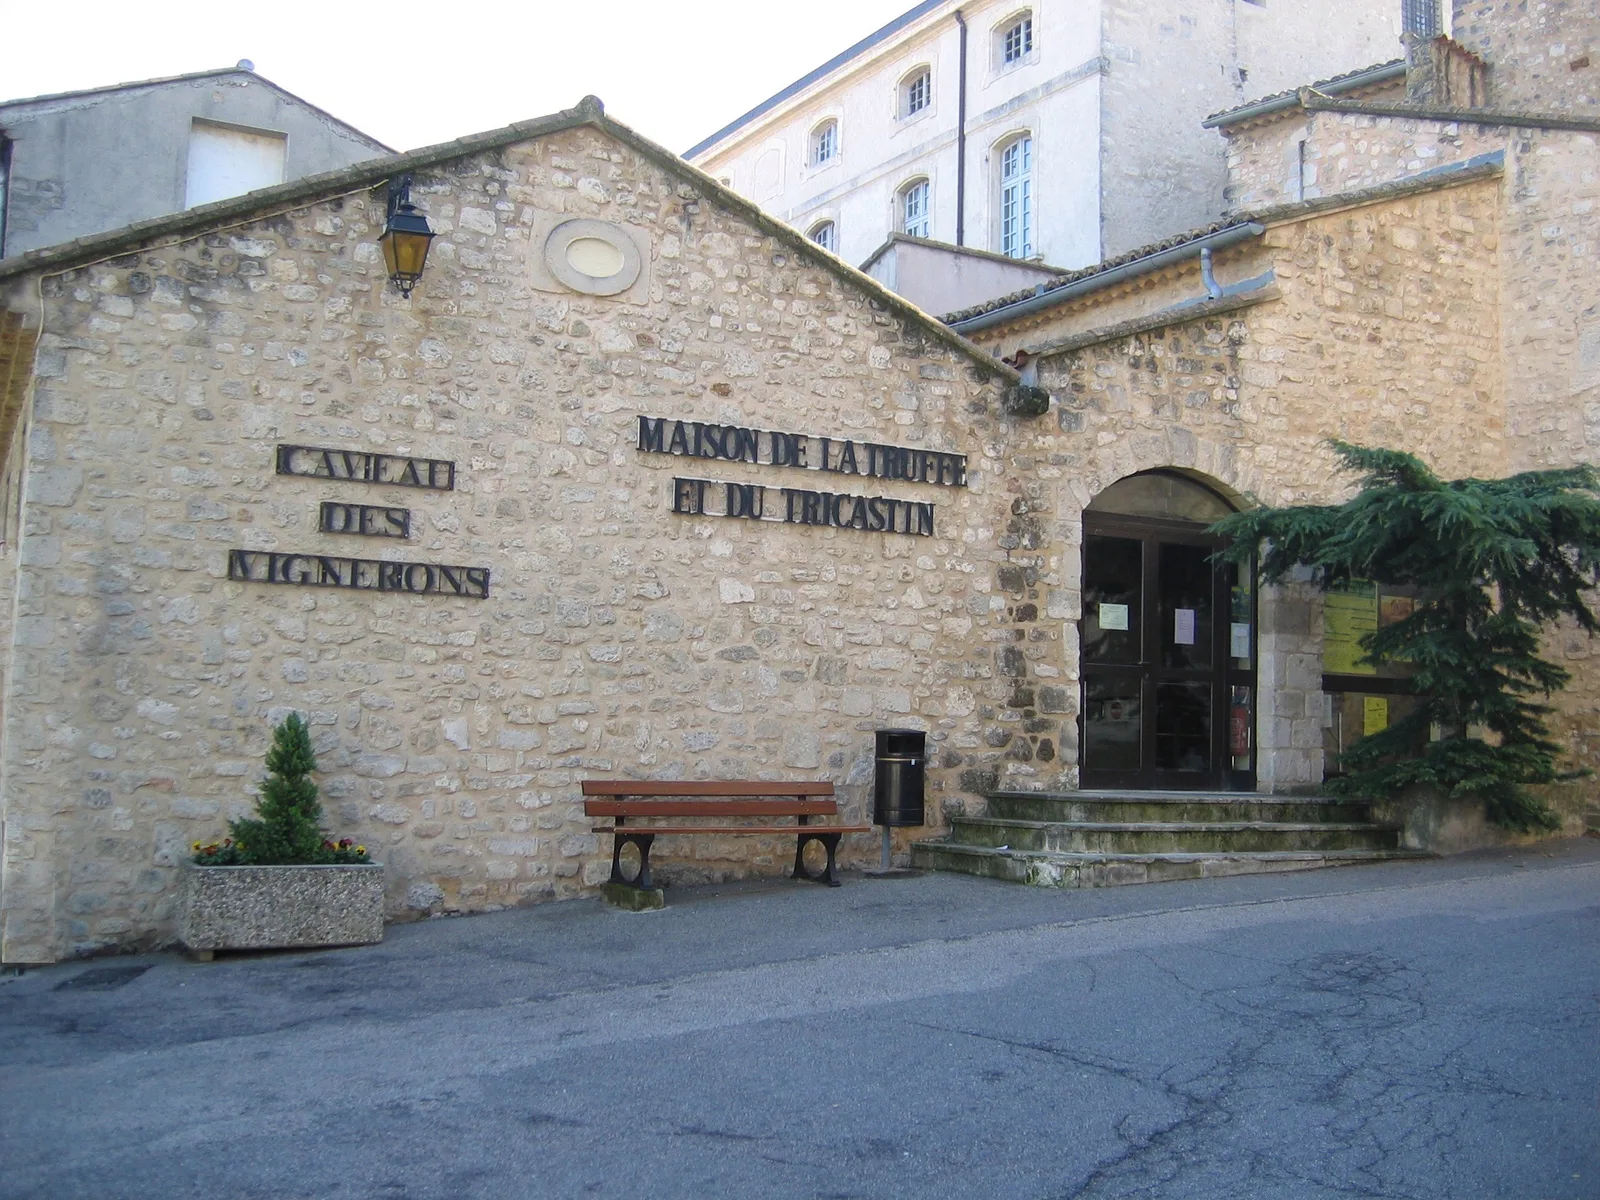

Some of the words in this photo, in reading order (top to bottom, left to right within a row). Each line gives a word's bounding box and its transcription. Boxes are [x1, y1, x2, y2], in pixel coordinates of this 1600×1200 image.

[278, 445, 454, 490] CAVEAU
[637, 415, 759, 463] MAISON
[770, 431, 808, 468] DE
[820, 438, 858, 475] LA
[862, 443, 967, 486] TRUFFE
[322, 502, 409, 537] DES
[672, 478, 710, 515] ET
[724, 483, 764, 519] DU
[782, 488, 936, 536] TRICASTIN
[230, 550, 489, 598] VIGNERONS
